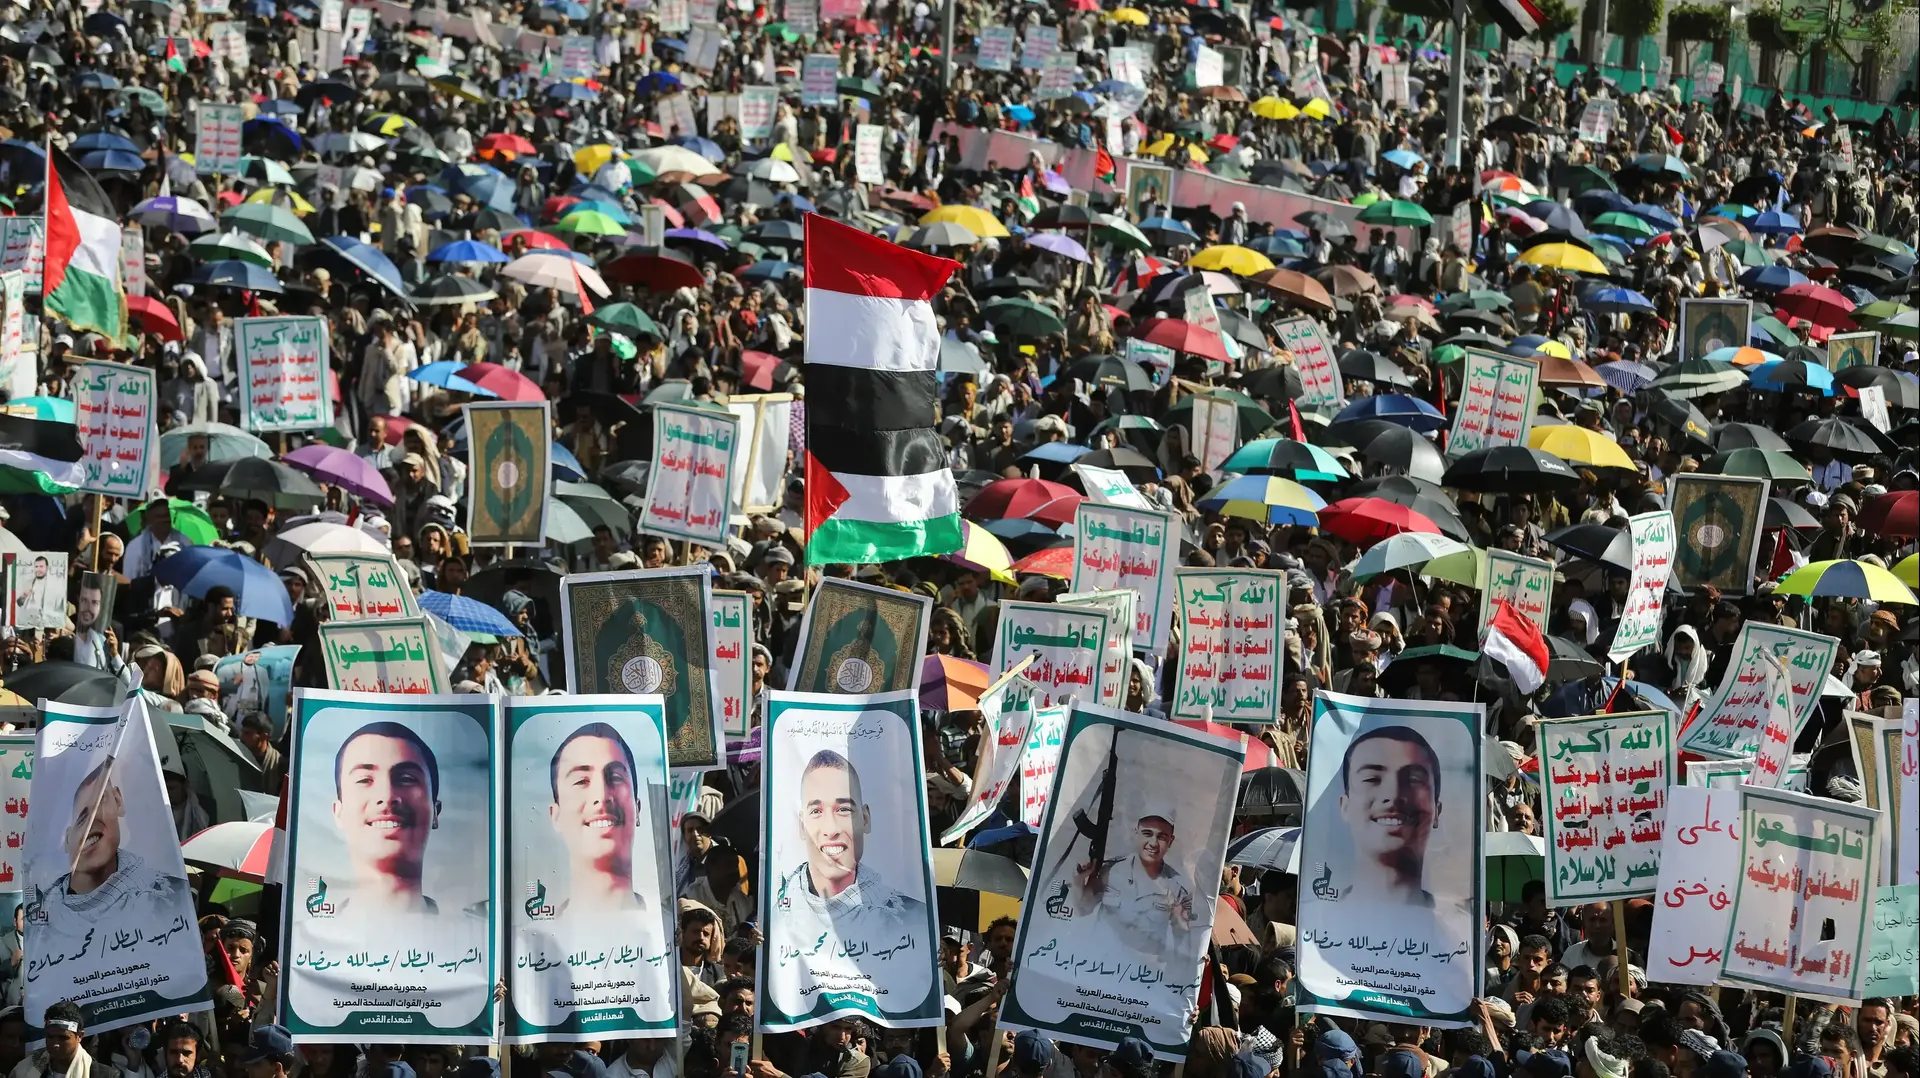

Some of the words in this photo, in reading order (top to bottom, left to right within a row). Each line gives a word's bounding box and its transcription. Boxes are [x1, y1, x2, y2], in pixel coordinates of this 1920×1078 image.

[250, 325, 289, 351] أكبر
[80, 369, 117, 395] أكبر
[118, 376, 147, 395] الله
[1505, 369, 1528, 386] الله
[1498, 392, 1526, 404] الموت
[112, 404, 146, 418] الموت
[1495, 408, 1523, 421] الموت
[110, 425, 145, 440] الموت
[663, 417, 730, 451] قاطعوا
[96, 445, 112, 460] على
[117, 445, 142, 461] اللعنة
[103, 465, 139, 486] النصر
[693, 456, 726, 479] البضائع
[1083, 514, 1161, 546] قاطعوا
[1083, 547, 1120, 573] الأمريكية
[1119, 555, 1158, 580] البضائع
[330, 561, 360, 593] أكبر
[368, 567, 396, 588] الله
[1492, 564, 1526, 589] أكبر
[1526, 571, 1547, 592] الله
[1187, 576, 1238, 608] أكبر
[1240, 580, 1274, 604] الله
[367, 598, 403, 616] الموت
[1518, 600, 1545, 613] الموت
[1188, 609, 1230, 630] لأمريكا
[1234, 613, 1273, 632] الموت
[1009, 622, 1098, 651] قاطعوا
[331, 635, 425, 670] قاطعوا
[1234, 639, 1273, 657] الموت
[1791, 645, 1826, 672] الله
[1054, 662, 1093, 687] البضائع
[1185, 663, 1216, 682] اليهود
[1218, 664, 1237, 683] على
[1242, 663, 1272, 680] اللعنة
[1229, 686, 1270, 714] النصر
[1739, 714, 1759, 730] على
[1550, 722, 1617, 763] أكبر
[1620, 723, 1663, 750] الله
[1552, 760, 1611, 787] لأمريكا
[1615, 760, 1663, 785] الموت
[1555, 793, 1613, 821] لإسرائيل
[1617, 789, 1664, 816] الموت
[1677, 794, 1723, 845] على
[1556, 826, 1598, 852] اليهود
[1603, 826, 1626, 850] على
[1751, 808, 1863, 860] قاطعوا
[1747, 856, 1803, 894] الأمريكية
[1317, 888, 1339, 898] رجال
[1804, 870, 1859, 906] البضائع
[311, 903, 335, 914] رجال
[530, 903, 555, 916] رجال
[1050, 905, 1073, 917] رجال
[1790, 906, 1798, 932] و
[147, 915, 189, 946] الشهيد
[68, 927, 95, 961] محمد
[805, 932, 827, 956] محمد
[872, 933, 915, 960] الشهيد
[1303, 929, 1343, 949] رمضان
[437, 947, 482, 973] الشهيد
[1027, 938, 1074, 970] ابراهيم
[1431, 940, 1471, 964] الشهيد
[1734, 931, 1851, 982] الإسرائيلية
[27, 953, 65, 983] صلاح
[116, 961, 150, 975] جمهورية
[296, 950, 341, 971] رمضان
[517, 951, 561, 972] رمضان
[1075, 959, 1120, 977] اسلام
[100, 969, 117, 980] مصر
[1351, 964, 1375, 974] العربية
[1374, 967, 1390, 976] مصر
[1389, 968, 1421, 979] جمهورية
[73, 970, 101, 985] العربية
[124, 976, 150, 990] القوات
[149, 975, 170, 986] صقور
[607, 980, 636, 989] جمهورية
[1336, 977, 1363, 987] المصرية
[1363, 980, 1393, 991] المسلحة
[91, 983, 124, 998] المسلحة
[350, 982, 377, 993] العربية
[377, 983, 394, 992] مصر
[394, 982, 428, 994] جمهورية
[570, 982, 594, 991] العربية
[594, 982, 607, 990] مصر
[1076, 986, 1101, 998] العربية
[1393, 985, 1417, 994] القوات
[1417, 988, 1436, 996] صقور
[119, 994, 146, 1009] شهداء
[332, 999, 363, 1008] المصرية
[363, 999, 396, 1007] المسلحة
[396, 999, 421, 1008] القوات
[553, 997, 583, 1008] المصرية
[583, 995, 609, 1006] المسلحة
[609, 994, 631, 1004] القوات
[631, 995, 650, 1004] صقور
[1100, 991, 1117, 1000] مصر
[1116, 994, 1149, 1007] جمهورية
[1362, 995, 1387, 1005] القدس
[1386, 998, 1410, 1007] شهداء
[93, 1000, 119, 1016] القدس
[421, 1000, 442, 1008] صقور
[1056, 998, 1086, 1010] المصرية
[1086, 1005, 1117, 1016] المسلحة
[359, 1015, 386, 1025] القدس
[386, 1015, 413, 1024] شهداء
[581, 1013, 603, 1024] القدس
[603, 1011, 624, 1021] شهداء
[1116, 1010, 1142, 1022] القوات
[1141, 1015, 1161, 1025] صقور
[1079, 1020, 1105, 1030] القدس
[1105, 1022, 1131, 1034] شهداء
